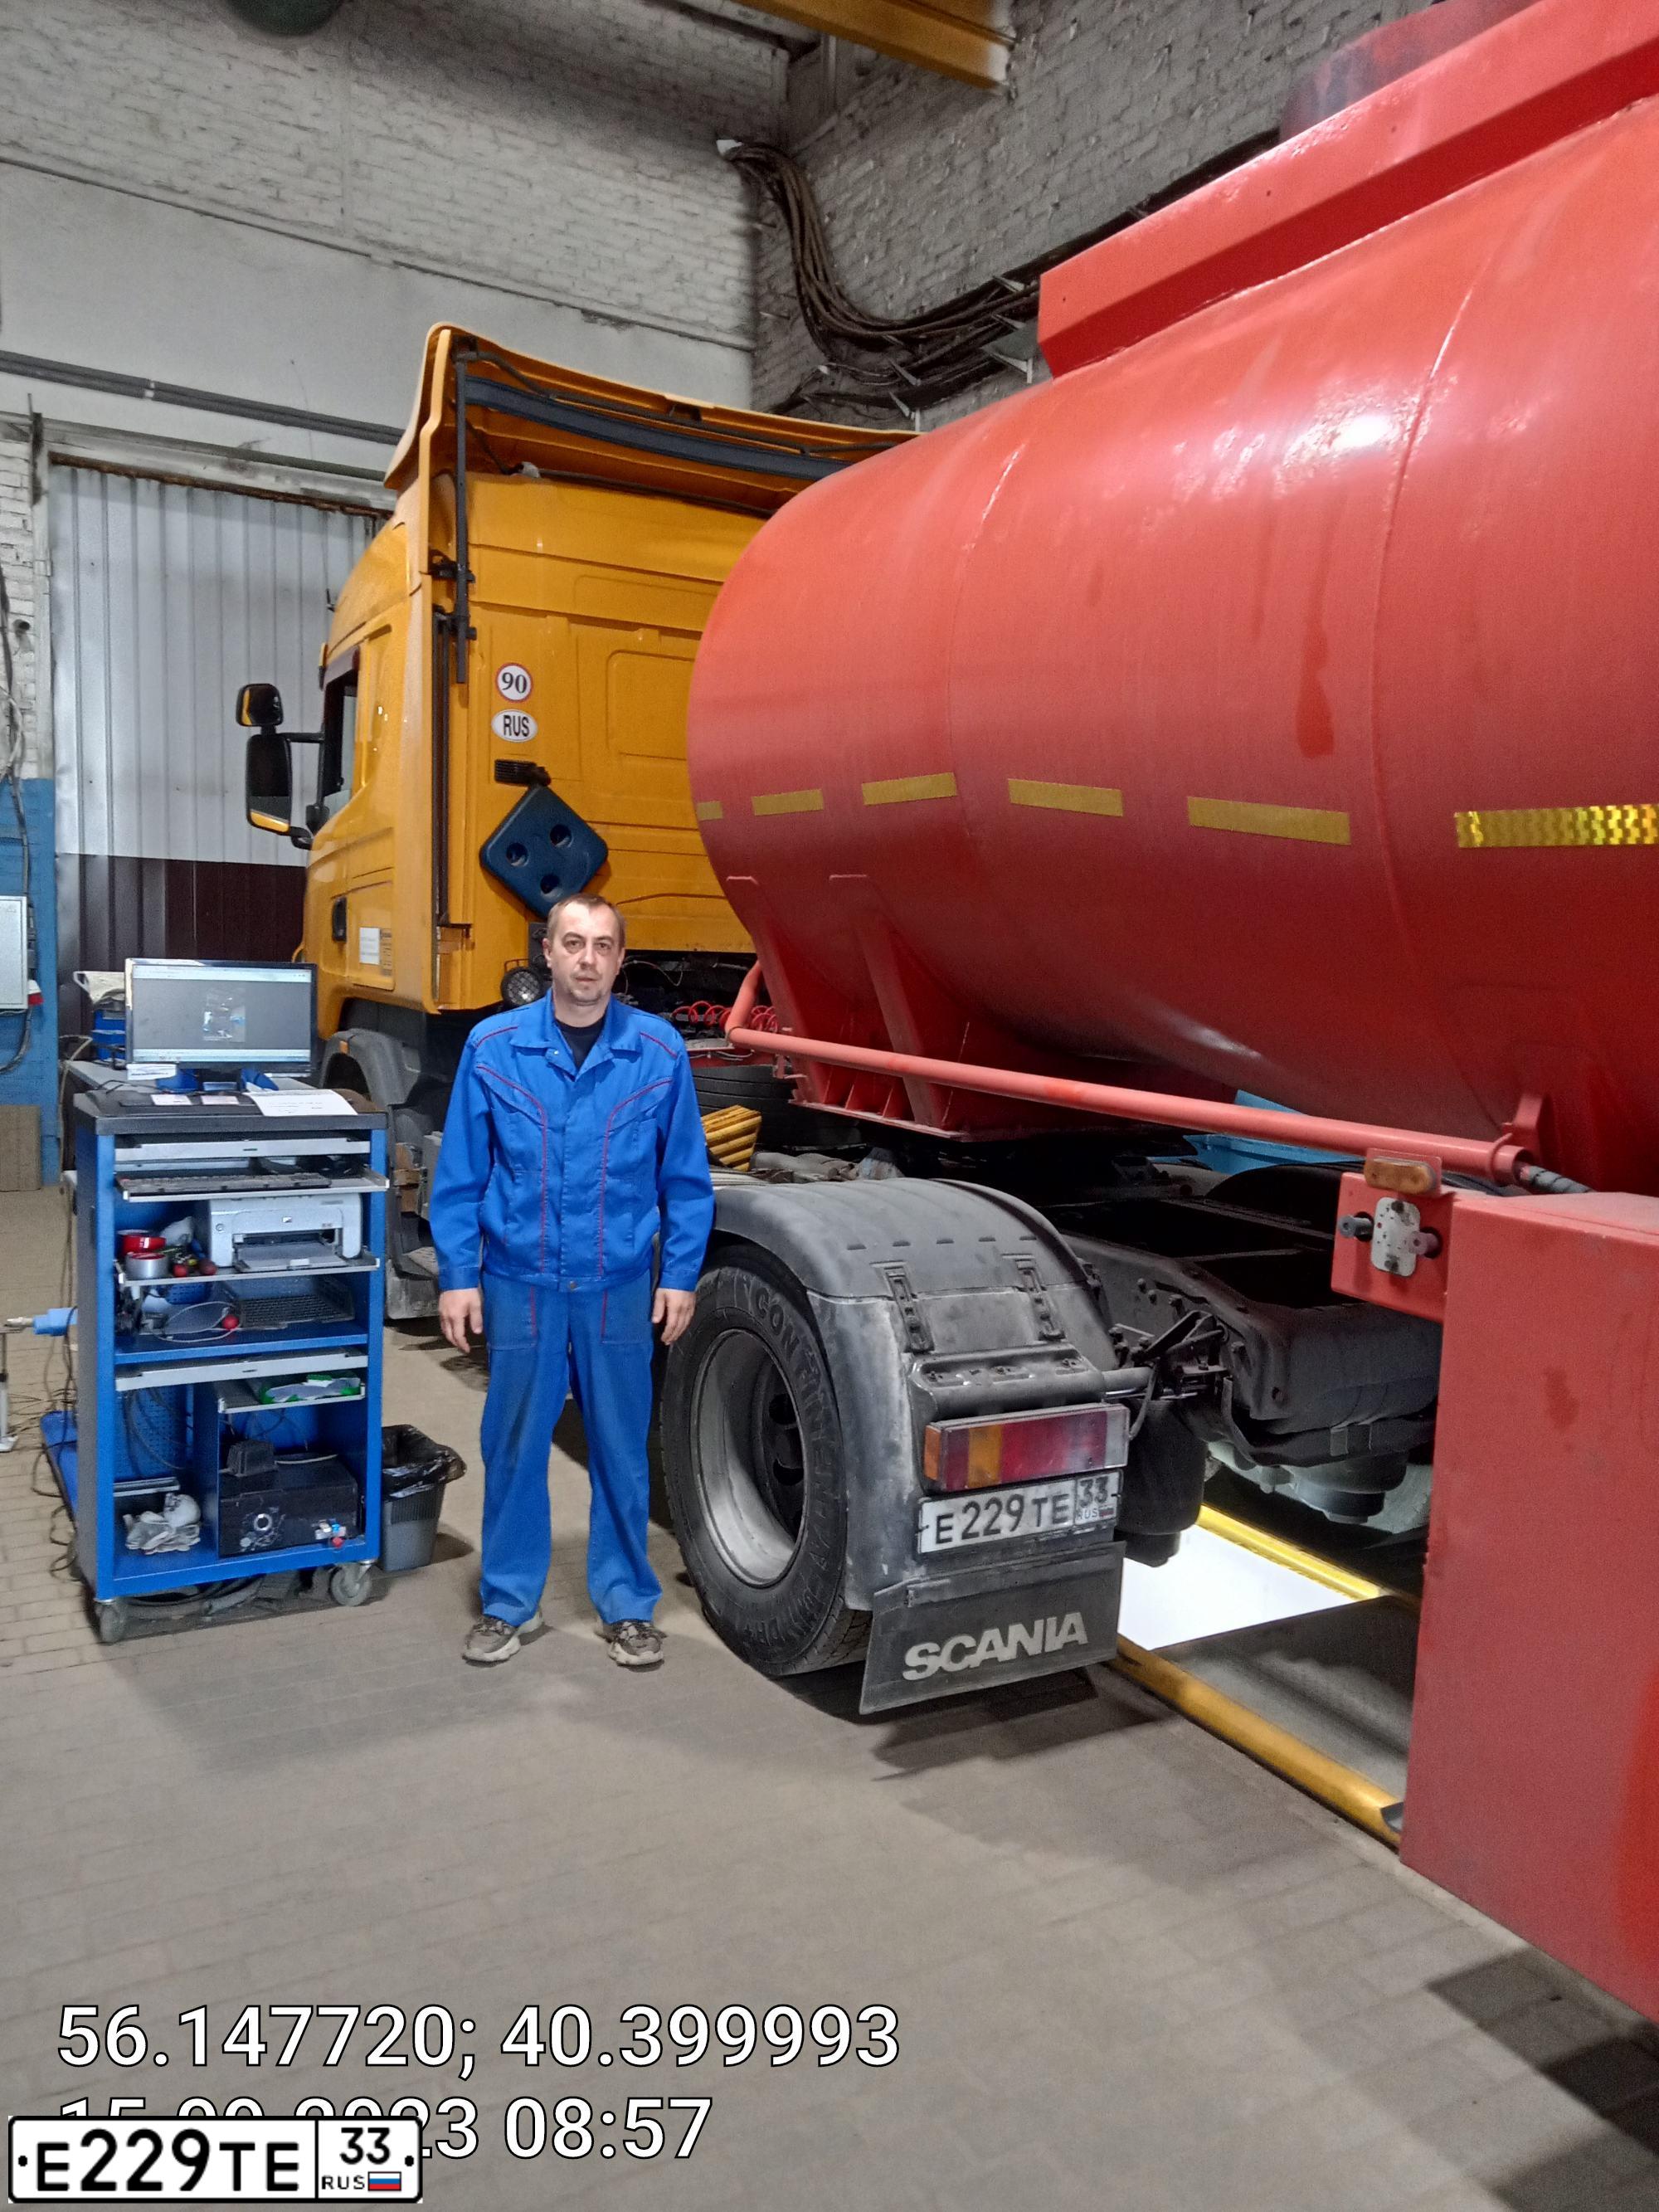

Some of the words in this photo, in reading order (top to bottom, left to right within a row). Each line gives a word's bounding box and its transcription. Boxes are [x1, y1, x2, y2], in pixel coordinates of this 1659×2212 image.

[501, 672, 528, 694] 90
[503, 714, 530, 738] RUS
[1079, 1475, 1110, 1508] 33
[902, 1611, 1089, 1681] SCANIA
